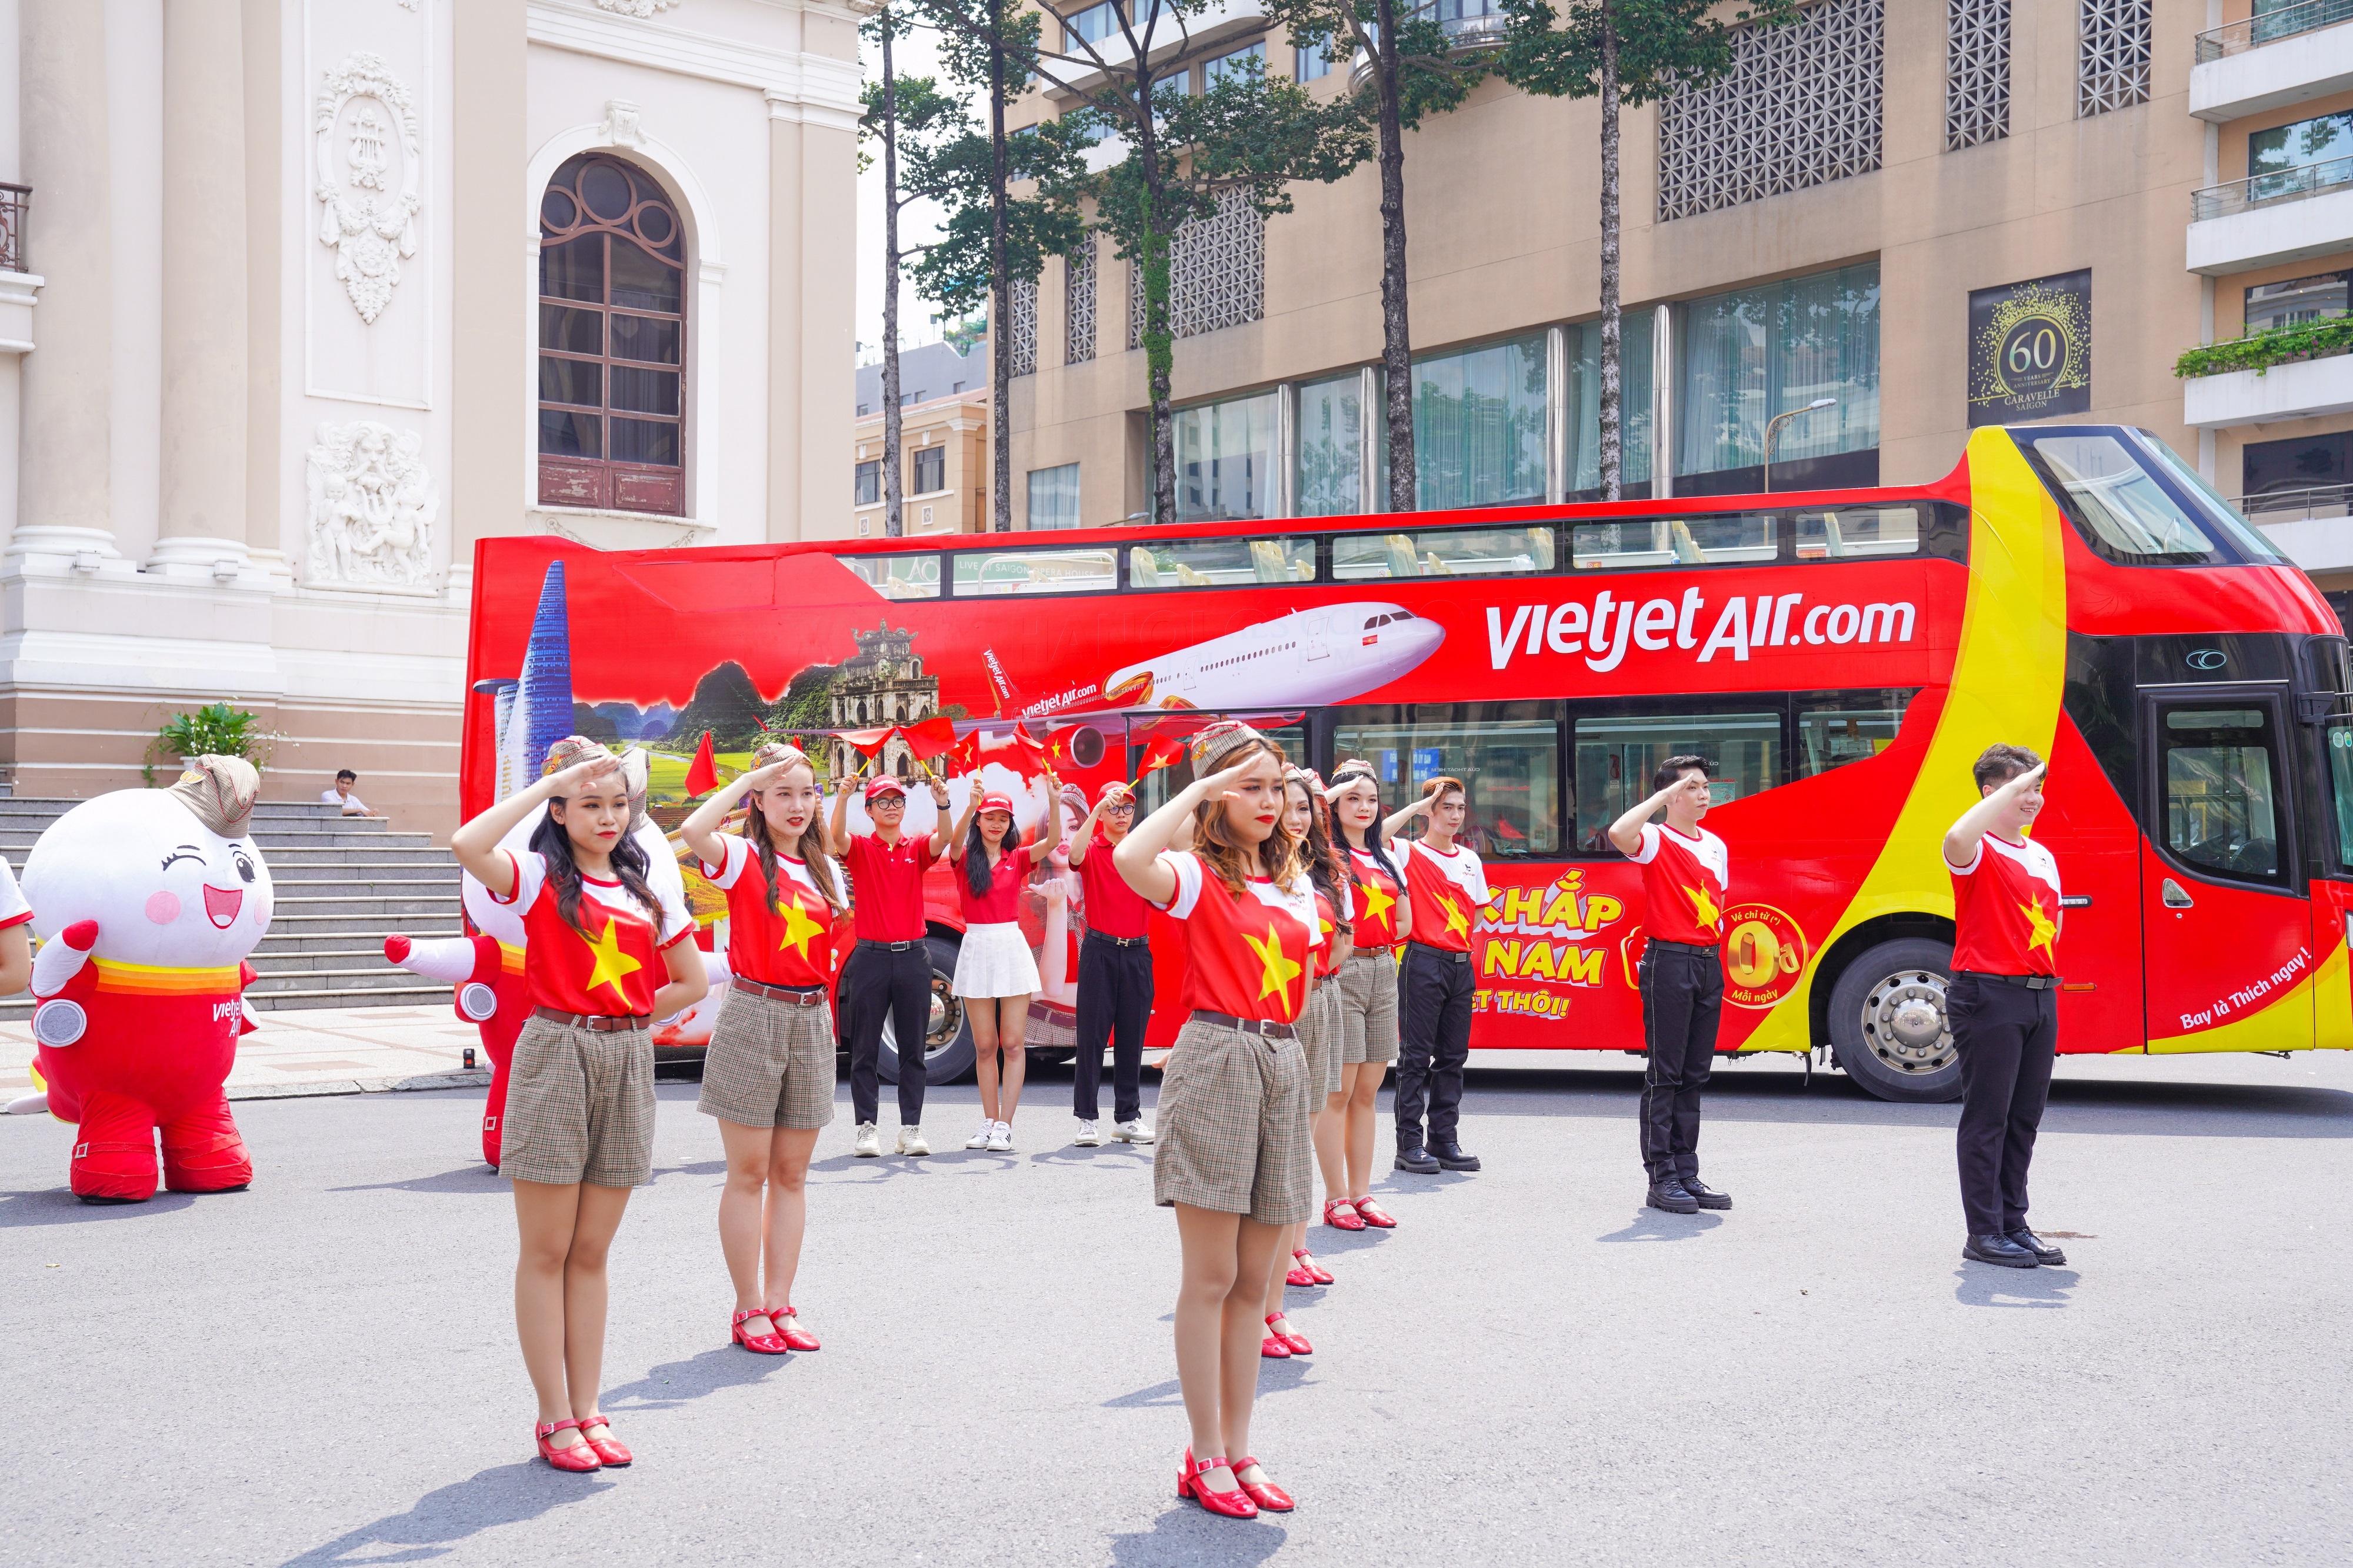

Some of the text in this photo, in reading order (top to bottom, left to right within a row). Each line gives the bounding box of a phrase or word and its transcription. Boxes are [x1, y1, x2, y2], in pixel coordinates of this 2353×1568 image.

[2009, 328, 2057, 373] 60
[2014, 378, 2051, 389] ANNIVERSARY
[2004, 388, 2060, 406] CARAVELLE
[2016, 399, 2047, 412] SAIGON
[959, 561, 978, 570] LIVE
[995, 563, 1029, 574] SAIGON
[1731, 912, 1742, 922] Vé
[1744, 909, 1758, 919] chỉ
[1759, 912, 1770, 920] từ
[1482, 938, 1608, 987] NAM
[1497, 989, 1571, 1019] THÔI!
[1731, 989, 1778, 1003] Mỗi ngày
[2179, 1009, 2211, 1029] Bay
[2213, 999, 2231, 1017] là
[2228, 980, 2271, 1008] Thích
